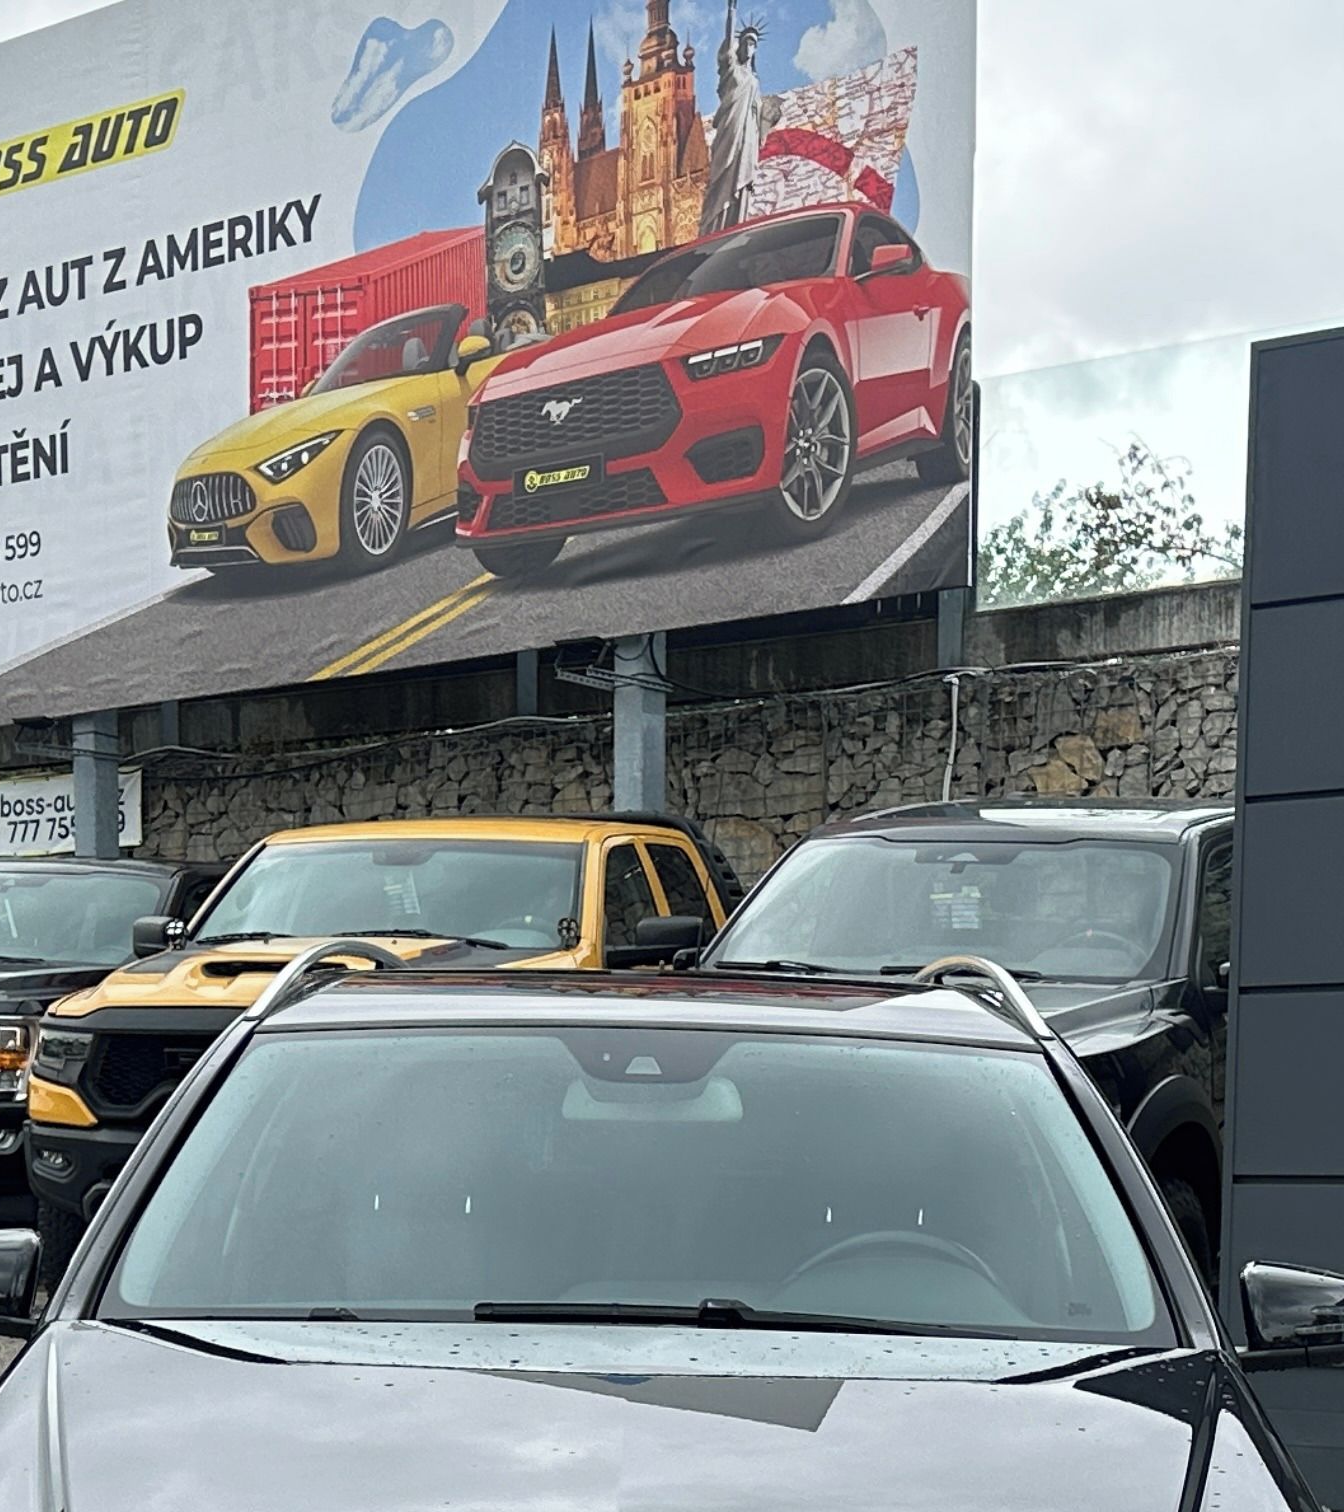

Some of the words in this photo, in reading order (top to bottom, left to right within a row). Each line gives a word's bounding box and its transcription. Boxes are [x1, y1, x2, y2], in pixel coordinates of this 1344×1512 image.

[57, 97, 179, 173] AUTO
[17, 256, 94, 315] AUT
[102, 247, 127, 293] Z
[136, 194, 322, 286] AMERIKY
[33, 348, 62, 393] A
[70, 314, 204, 382] VÝKUP
[4, 530, 41, 560] 599
[7, 819, 39, 843] 777
